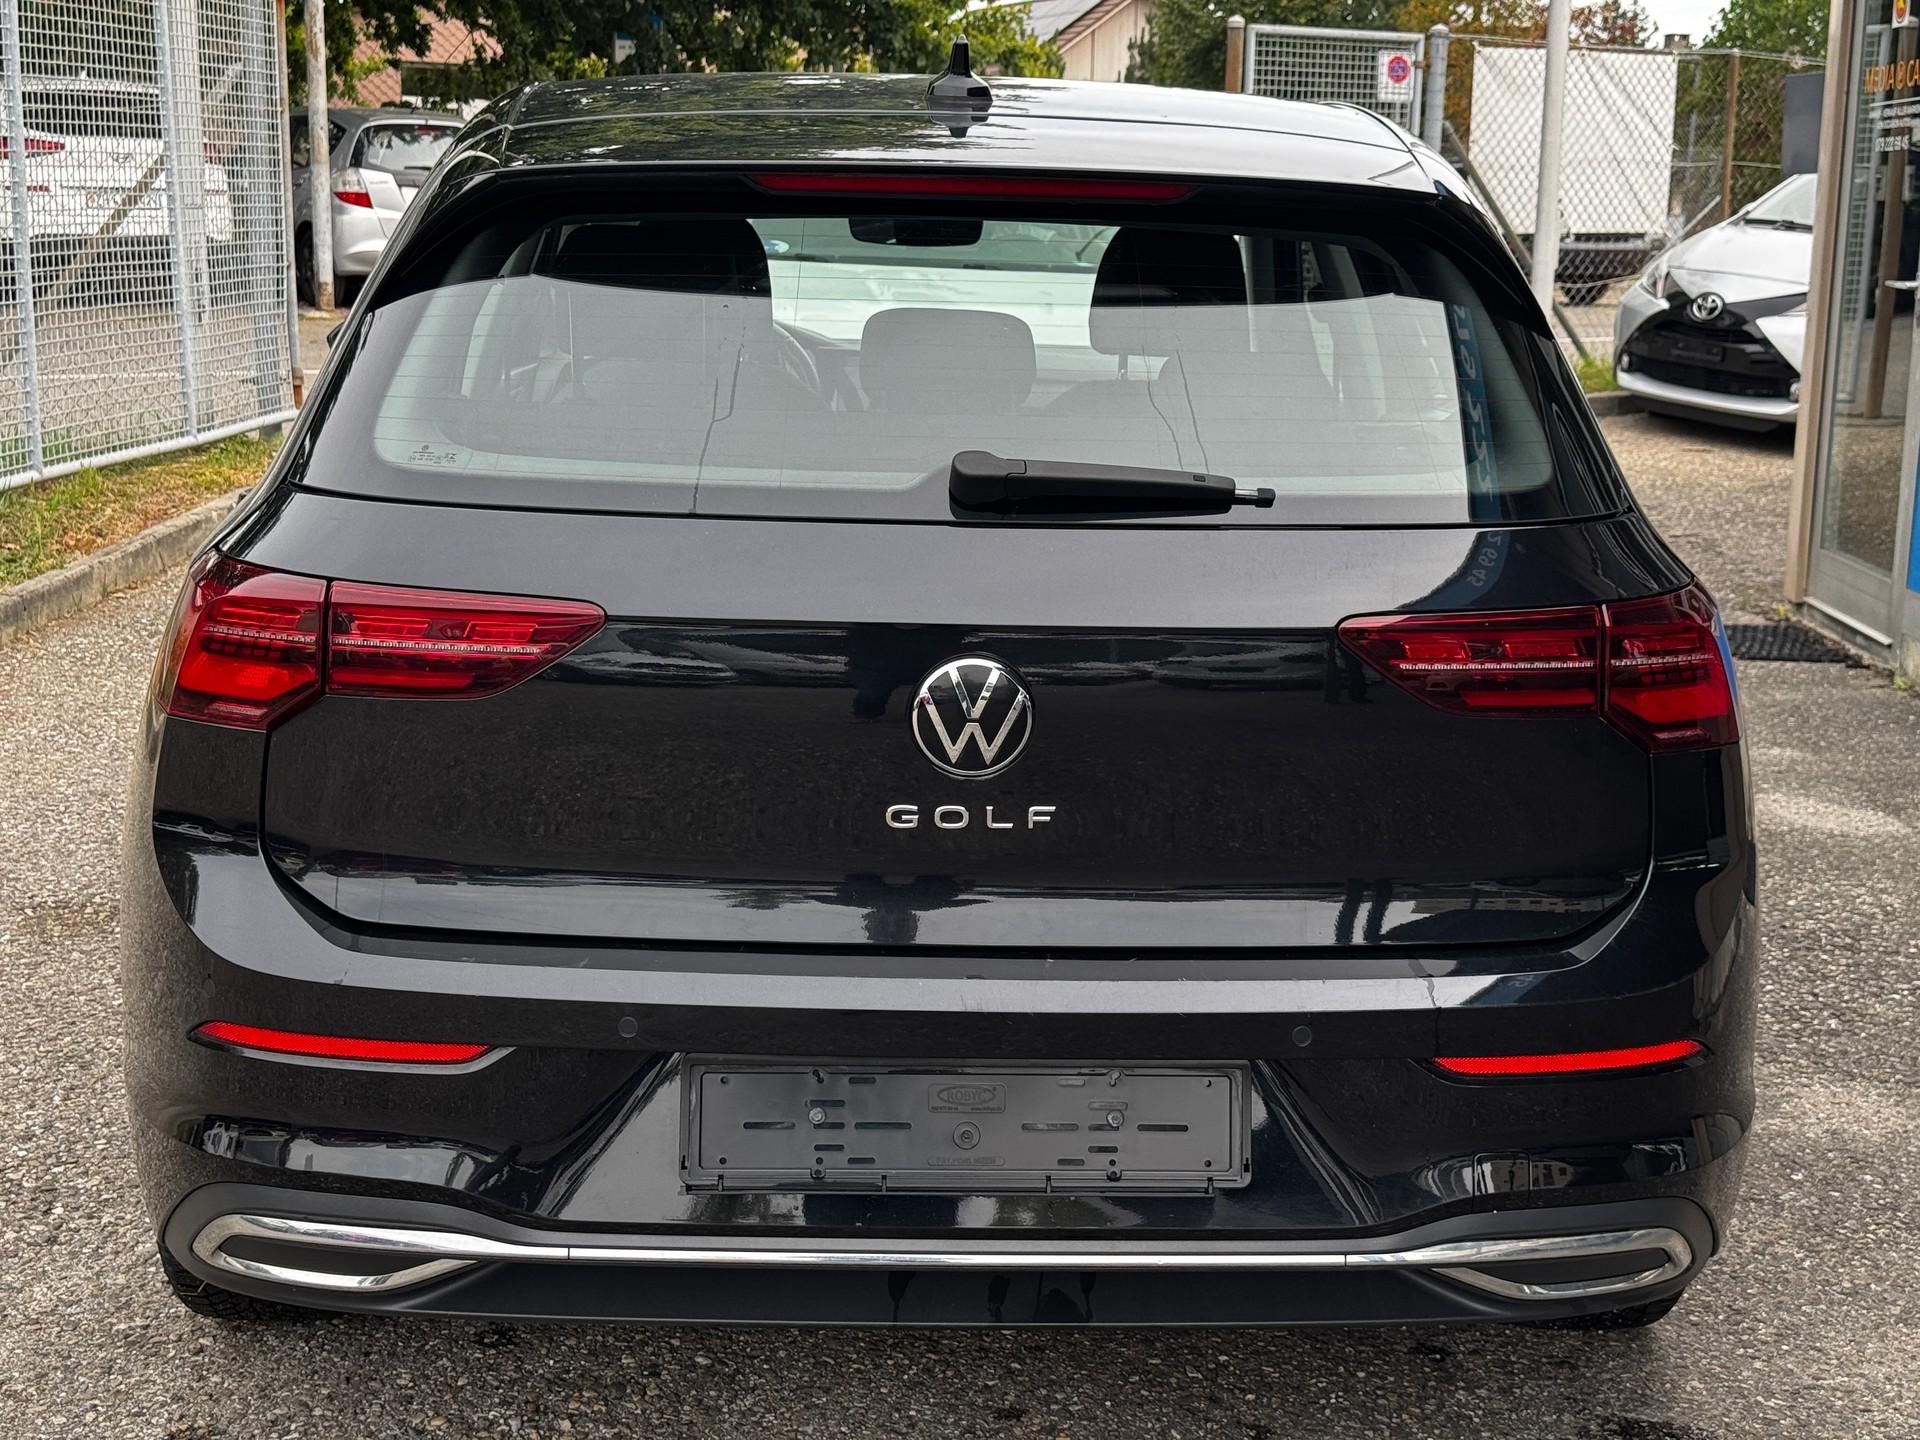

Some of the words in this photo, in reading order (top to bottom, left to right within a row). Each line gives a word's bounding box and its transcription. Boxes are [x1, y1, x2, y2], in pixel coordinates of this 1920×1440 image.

[1865, 64, 1894, 93] MEDIA
[885, 804, 1057, 829] GOLF
[946, 1090, 987, 1103] ROBYC
